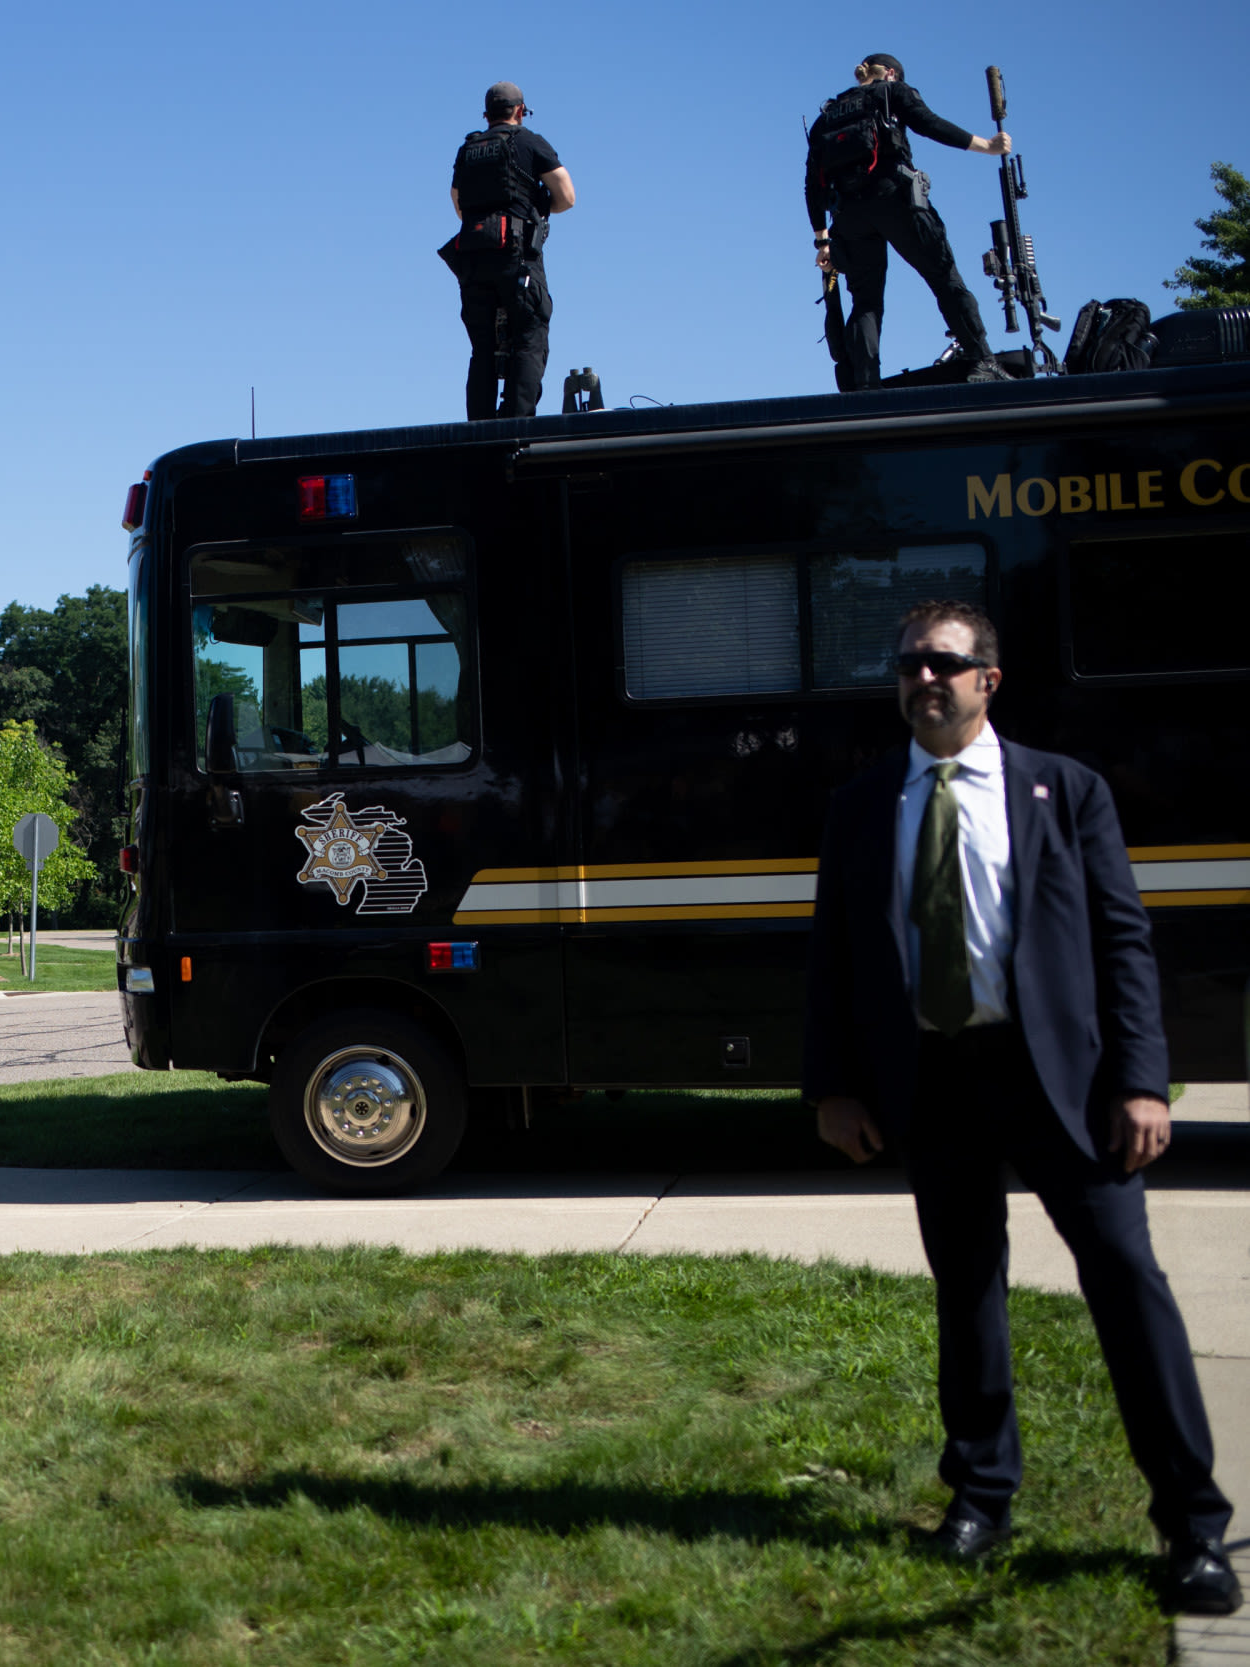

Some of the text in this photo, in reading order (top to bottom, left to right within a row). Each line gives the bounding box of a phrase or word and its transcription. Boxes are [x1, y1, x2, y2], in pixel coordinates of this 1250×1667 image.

[465, 144, 500, 161] POLICE
[966, 470, 1165, 520] MOBILE
[318, 829, 363, 845] SHERIFF
[316, 867, 369, 877] MACOMB COUNTY
